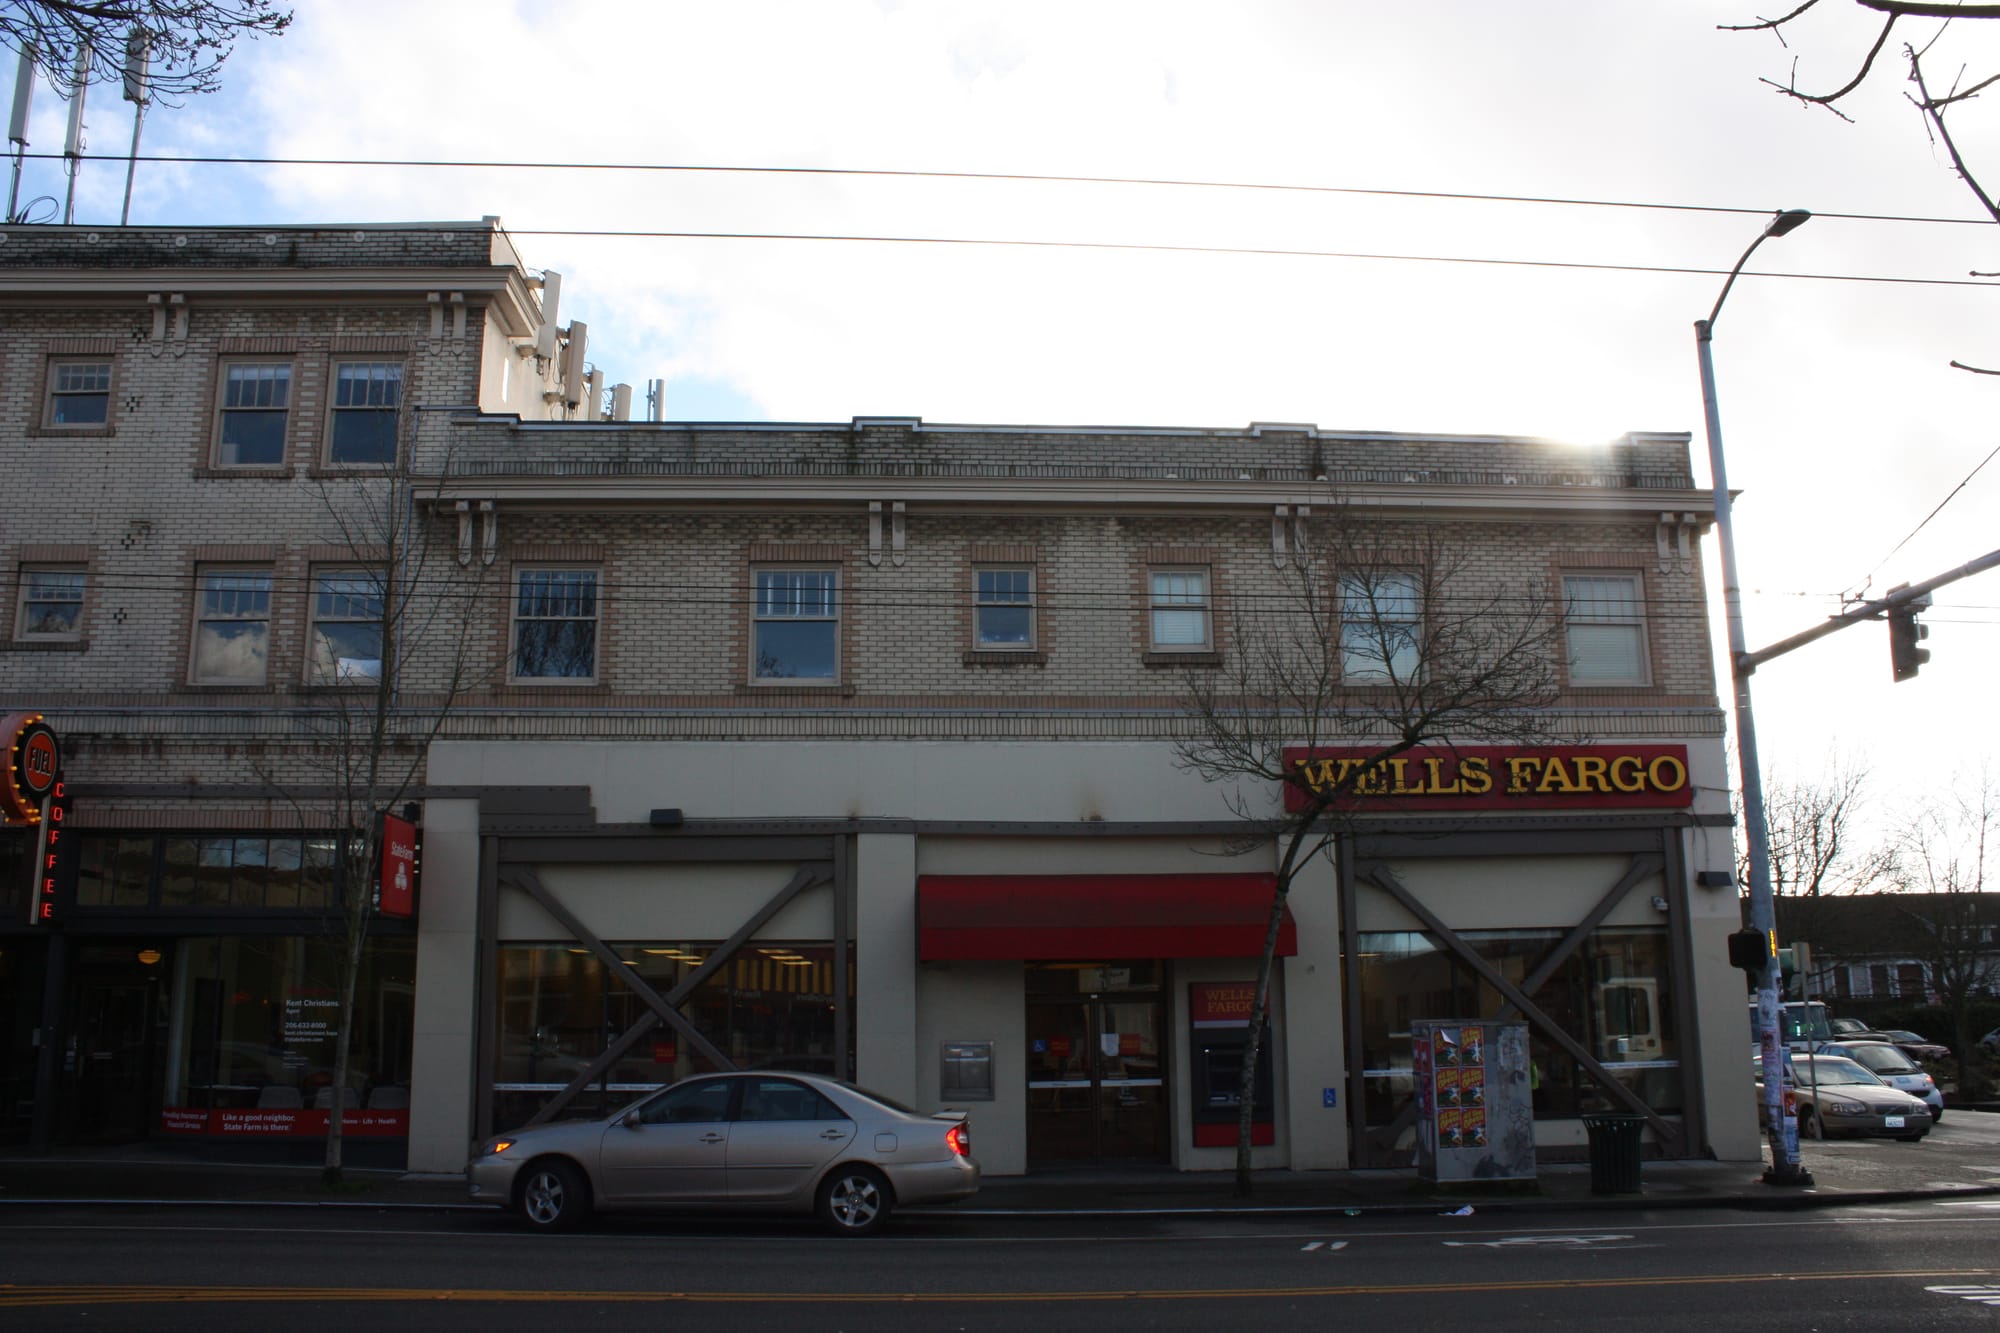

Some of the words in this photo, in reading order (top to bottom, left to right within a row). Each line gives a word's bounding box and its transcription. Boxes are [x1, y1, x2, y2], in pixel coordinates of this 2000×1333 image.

[29, 747, 51, 777] FUEL
[1295, 756, 1493, 795] WELLS
[1505, 755, 1686, 793] FARGO
[40, 781, 65, 919] COFFEE
[1206, 989, 1254, 1000] WELLS
[222, 1113, 237, 1121] Like
[244, 1114, 262, 1123] good
[362, 1117, 373, 1125] Life
[377, 1117, 397, 1125] Health
[223, 1122, 242, 1131] State
[243, 1123, 262, 1131] Farm
